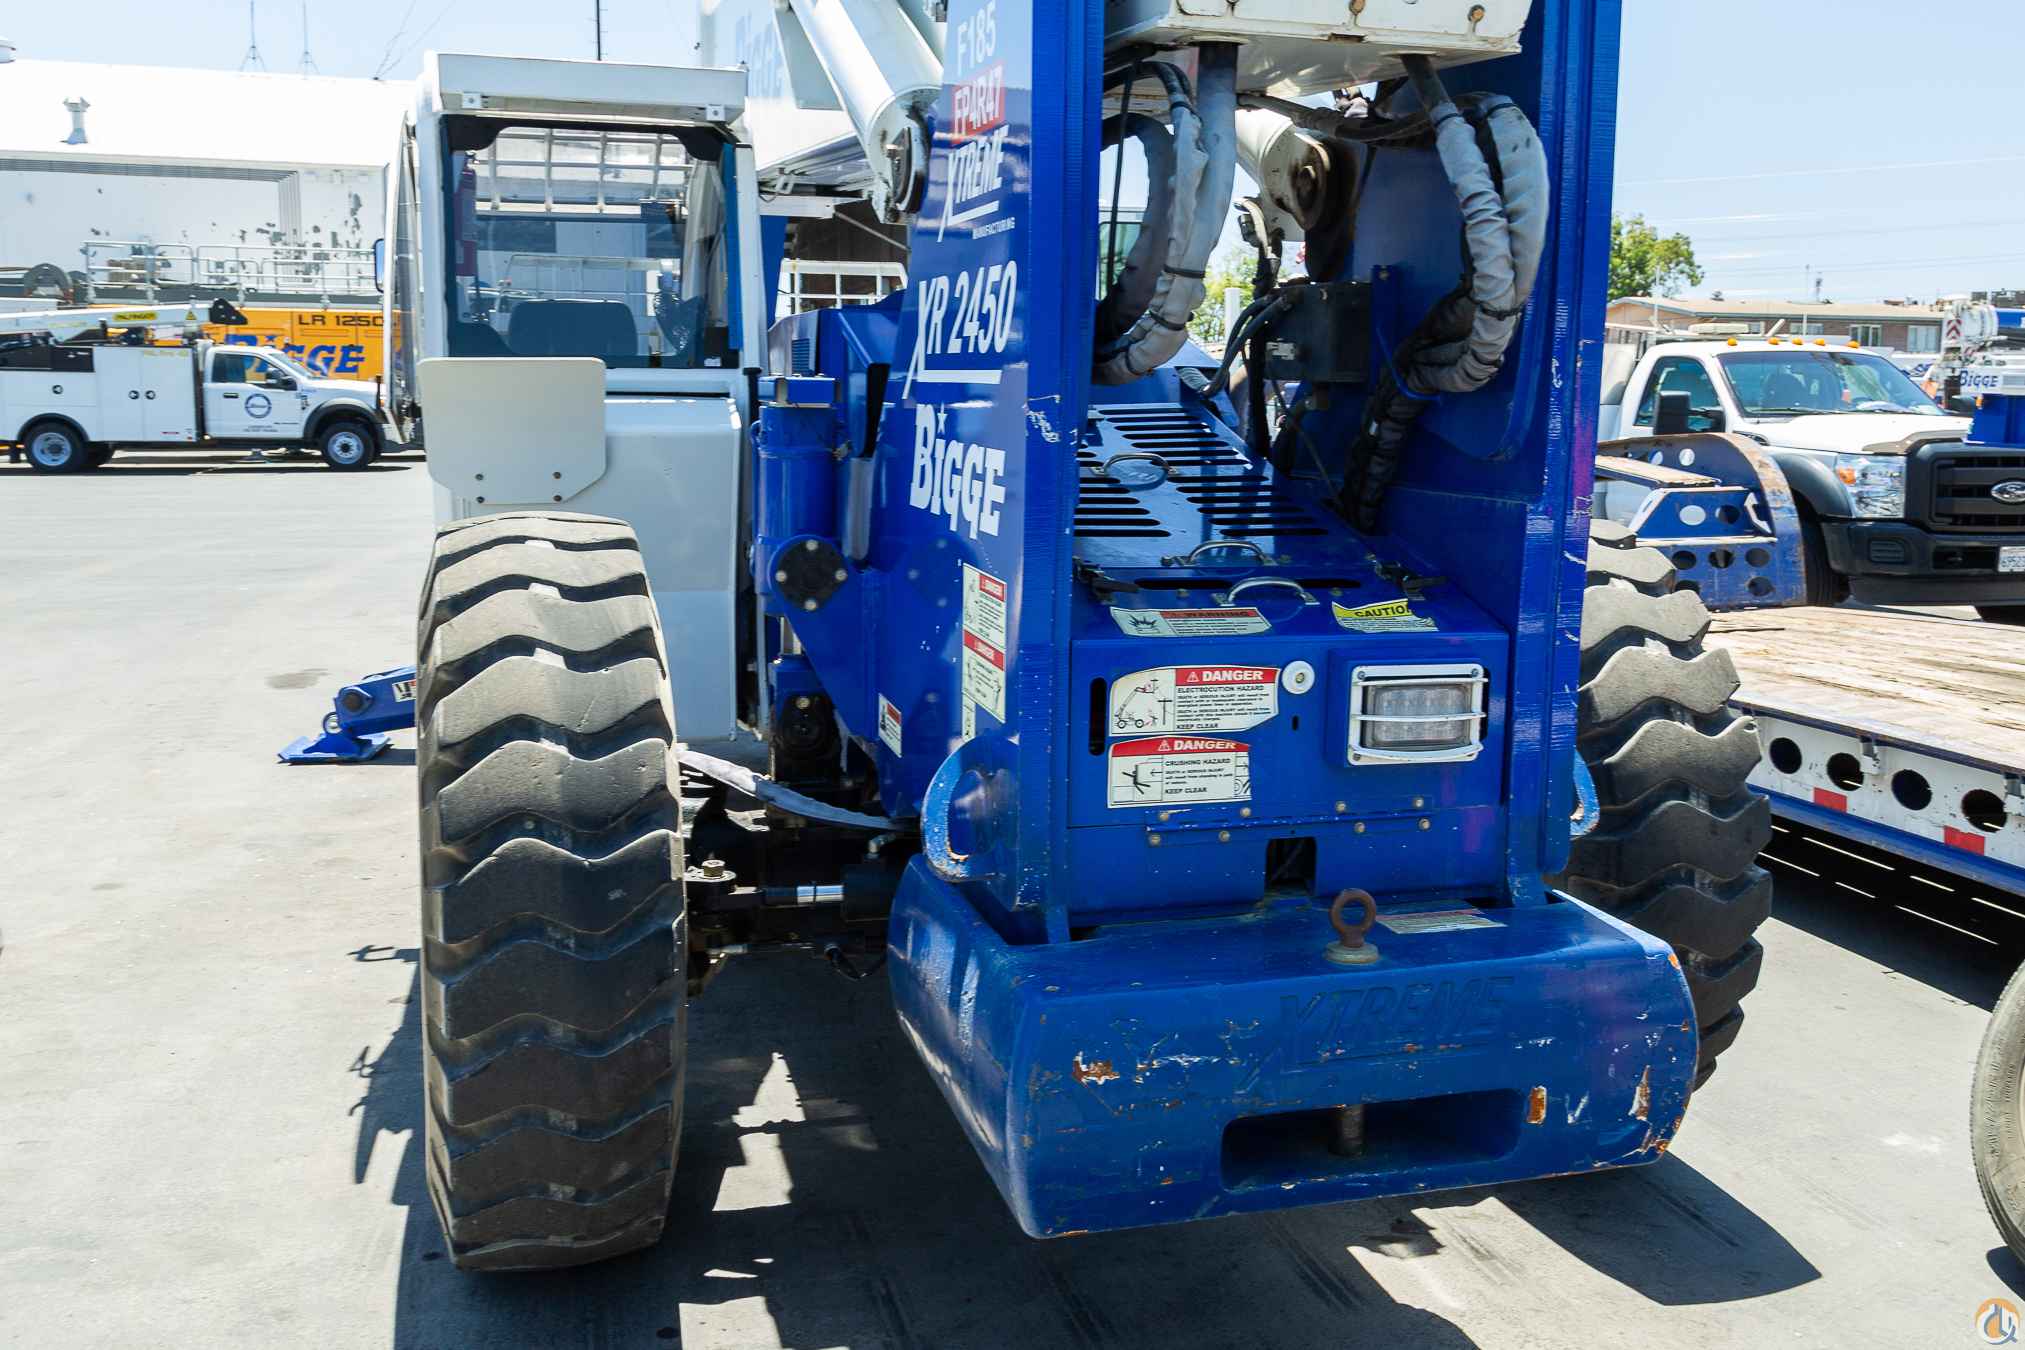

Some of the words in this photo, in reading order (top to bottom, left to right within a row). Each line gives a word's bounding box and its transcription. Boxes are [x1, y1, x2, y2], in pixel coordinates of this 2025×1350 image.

[957, 0, 996, 77] F185
[937, 124, 1009, 242] XTREME
[948, 260, 1017, 354] 2450
[298, 315, 326, 326] LR
[1354, 605, 1410, 617] CAUTIO
[1202, 670, 1264, 682] DANGER
[1177, 686, 1235, 694] ELECTROCUTION
[1173, 740, 1237, 751] DANGER
